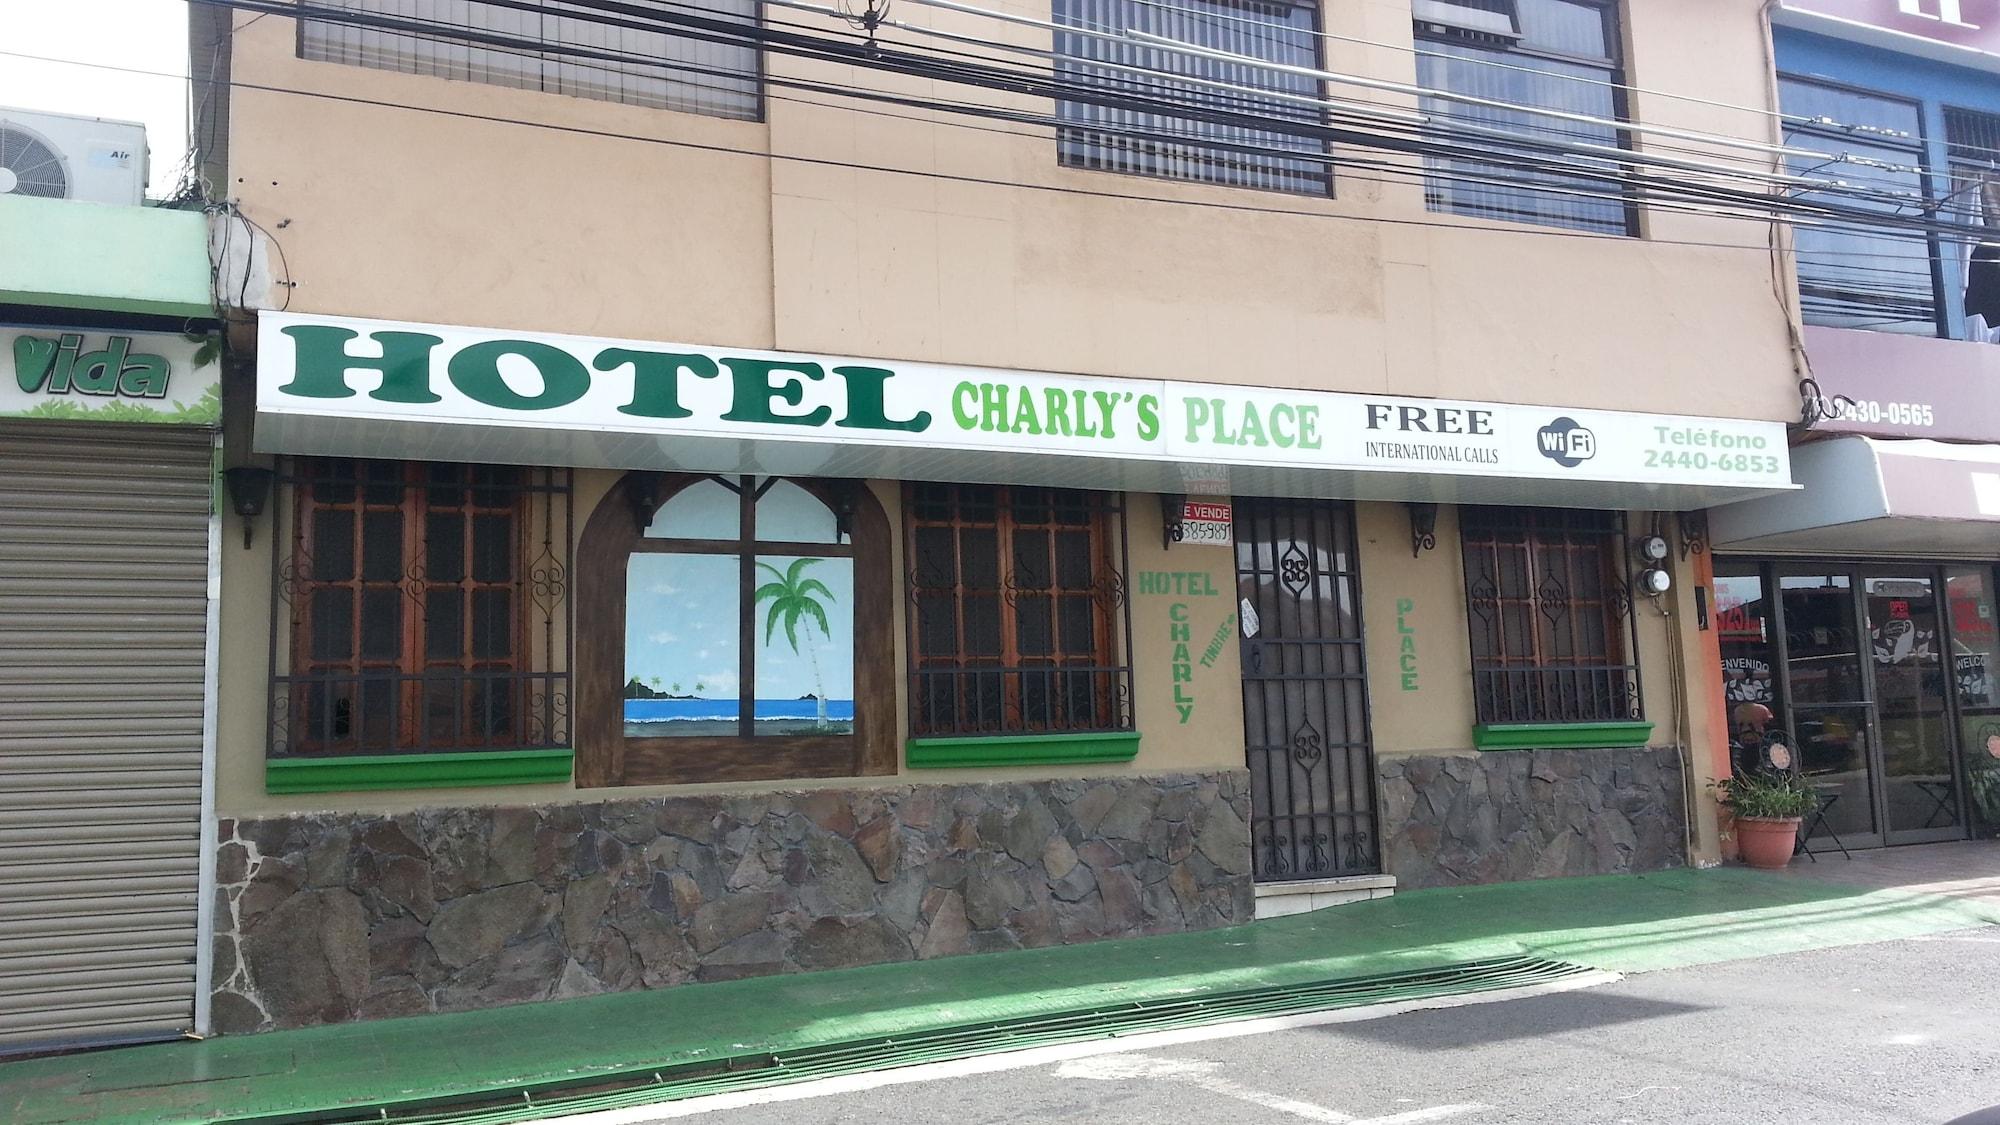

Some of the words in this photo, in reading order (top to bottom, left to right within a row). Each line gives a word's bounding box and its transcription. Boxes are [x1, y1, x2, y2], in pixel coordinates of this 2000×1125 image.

[110, 151, 130, 159] Air
[13, 334, 171, 398] Vida
[278, 325, 931, 432] HOTEL
[952, 381, 1159, 441] CHARLY'S
[1182, 397, 1322, 450] PLACE
[1364, 403, 1493, 435] FREE
[1833, 398, 1933, 426] 2430-0565
[1654, 426, 1766, 449] Teléfono
[1366, 441, 1462, 462] INTERNATIONAL
[1464, 447, 1498, 464] CALLS
[1644, 449, 1779, 473] 2440-6853
[1194, 506, 1230, 519] VENDE
[1138, 571, 1218, 596] HOTEL
[1396, 598, 1418, 690] PLACE
[1169, 603, 1193, 723] CHARLY
[1721, 658, 1770, 672] ENVENIDO
